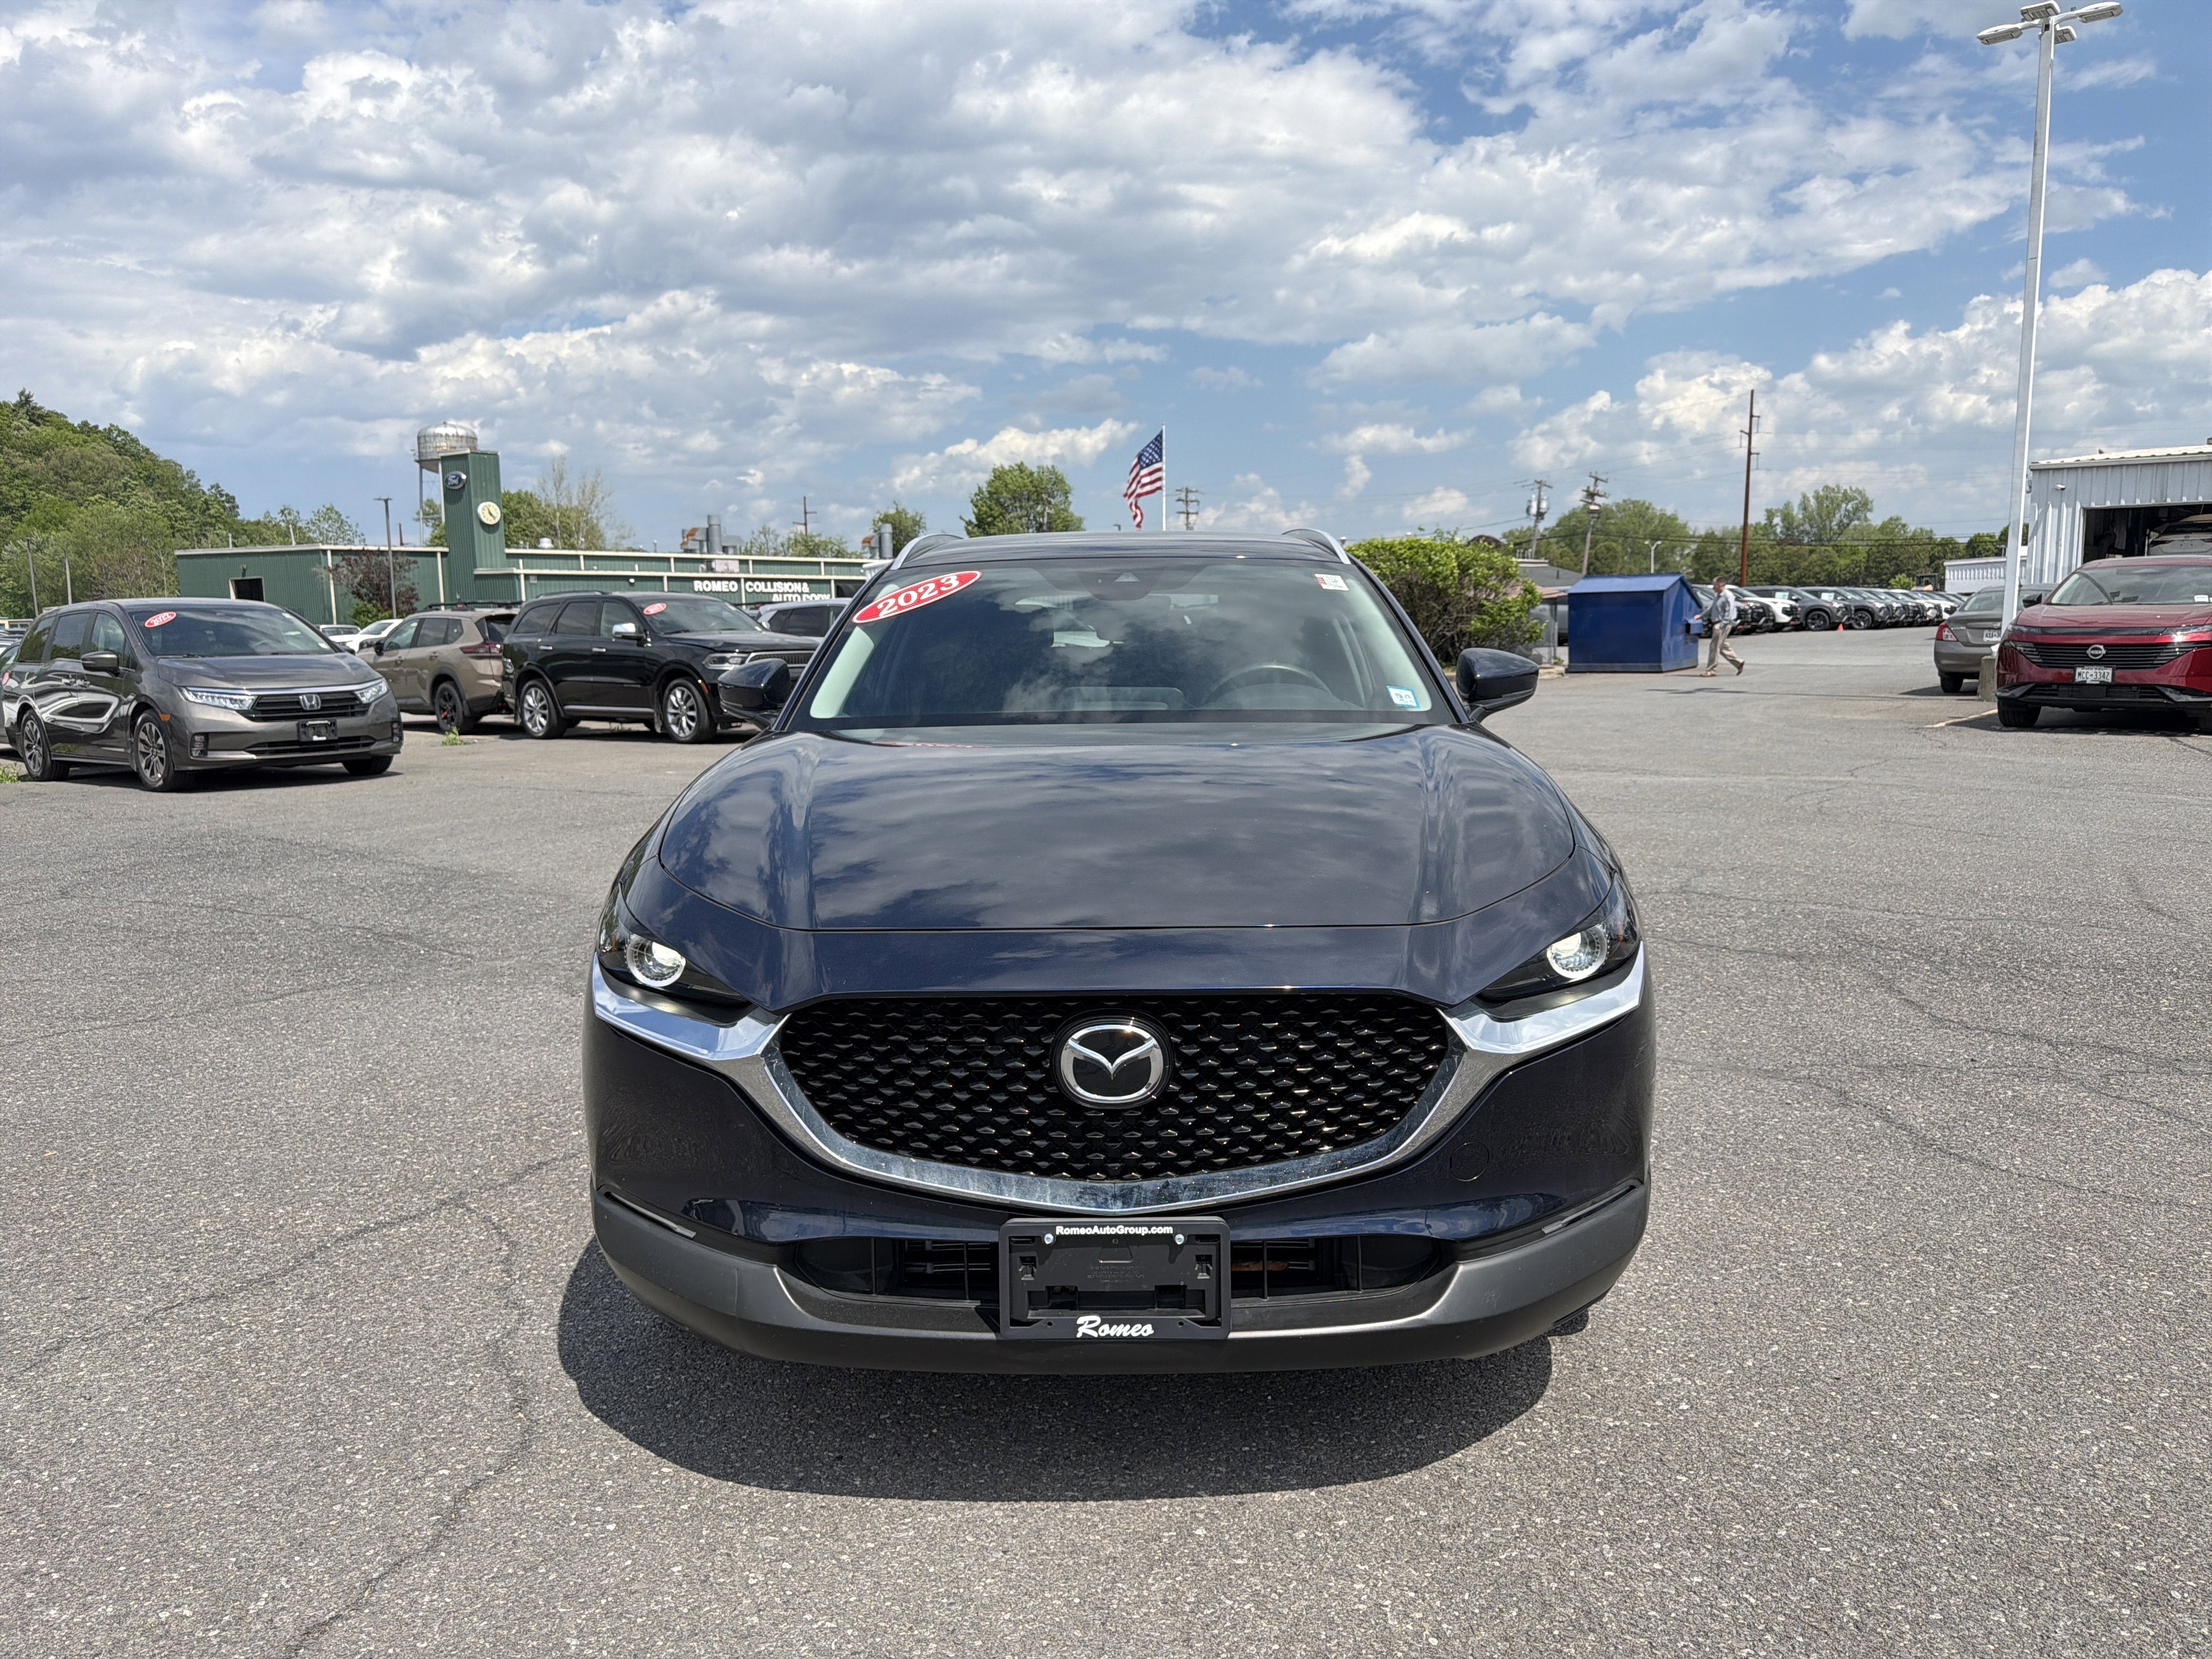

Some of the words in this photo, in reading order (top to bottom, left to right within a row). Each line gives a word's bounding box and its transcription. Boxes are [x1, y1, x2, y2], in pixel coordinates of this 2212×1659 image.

[693, 580, 738, 592] ROMEO
[877, 575, 960, 618] 2023
[1056, 1225, 1173, 1236] RomeoAutoGroup.com
[1076, 1315, 1154, 1338] Romeo
